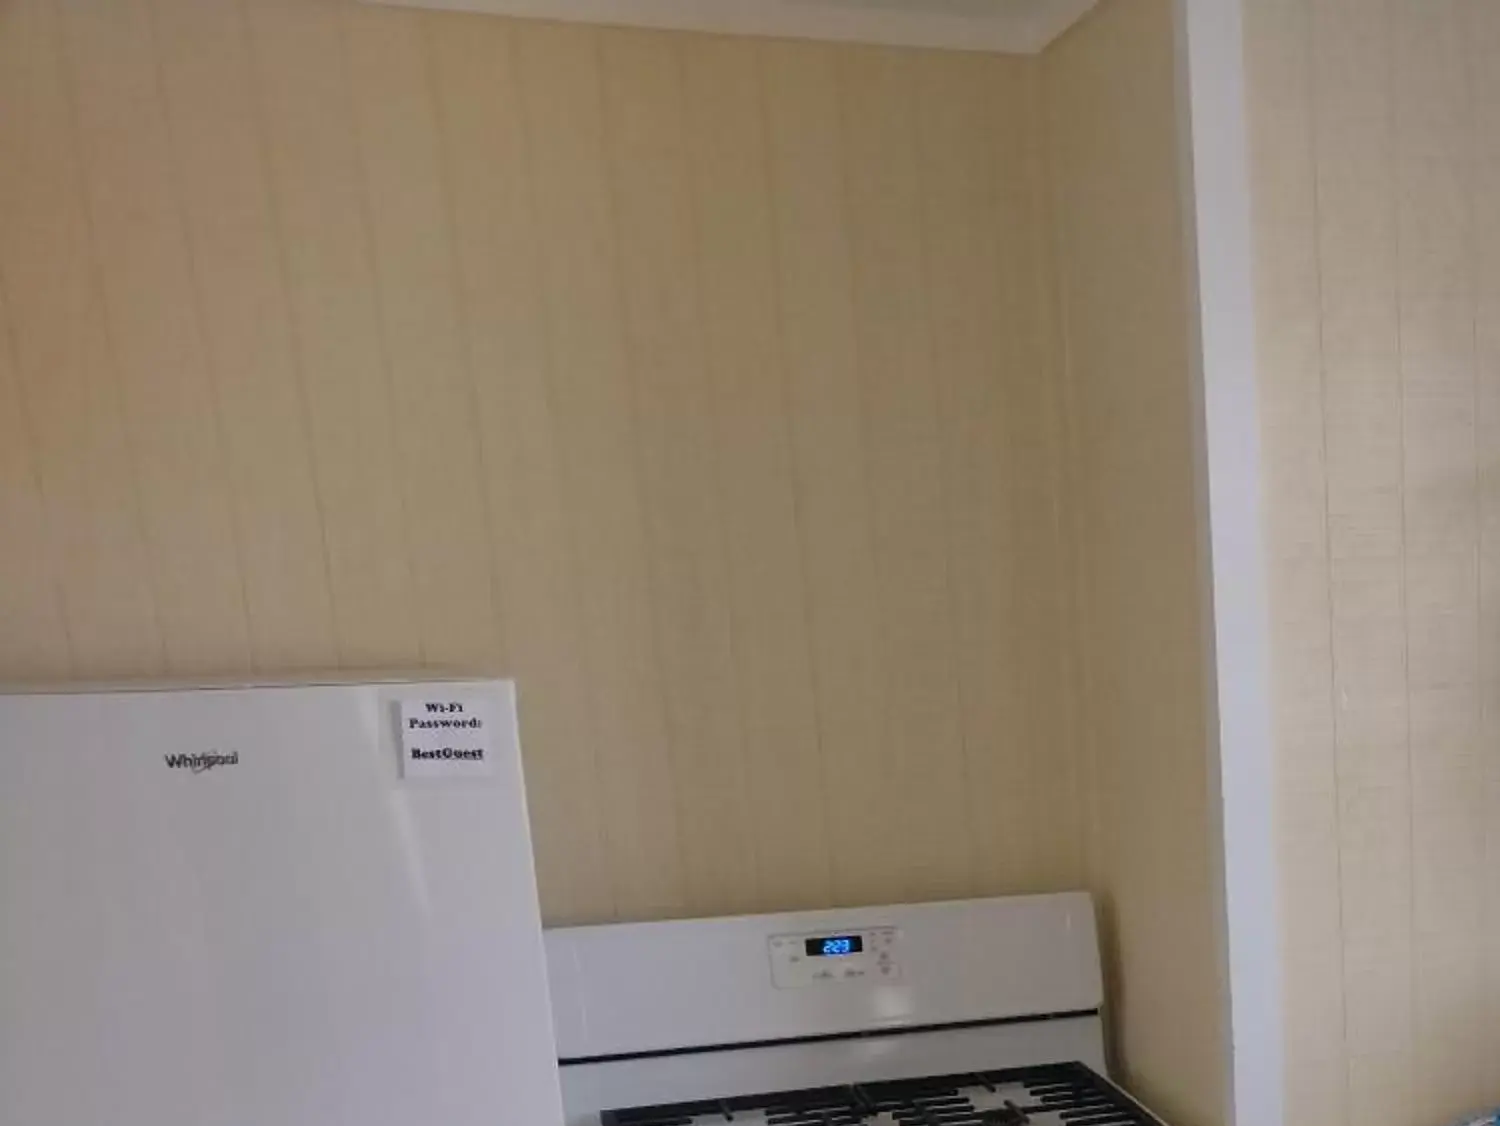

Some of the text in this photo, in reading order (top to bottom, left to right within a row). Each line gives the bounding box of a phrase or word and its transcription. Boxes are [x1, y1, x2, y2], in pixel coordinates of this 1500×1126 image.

[425, 703, 463, 713] Wi-Fi
[409, 717, 482, 729] Password:
[164, 751, 239, 770] Whirlpool
